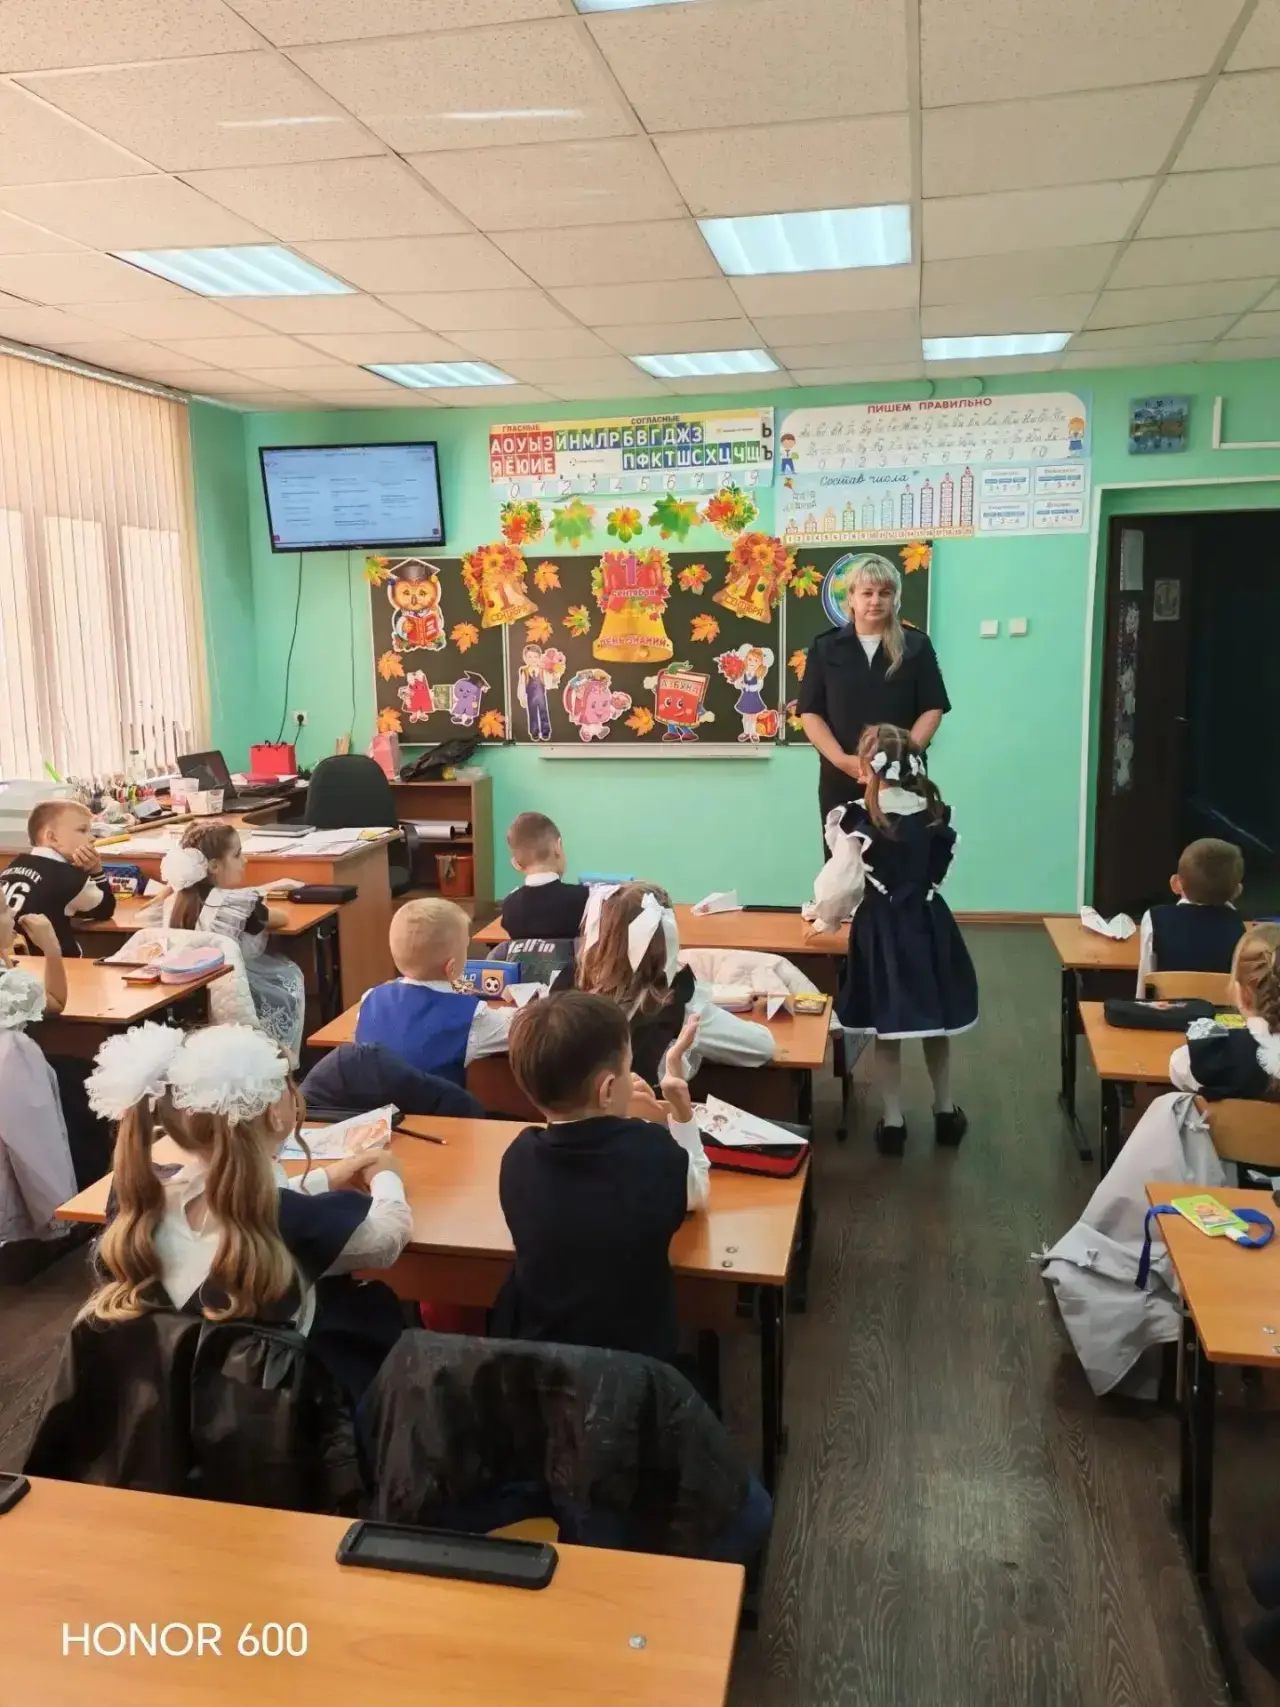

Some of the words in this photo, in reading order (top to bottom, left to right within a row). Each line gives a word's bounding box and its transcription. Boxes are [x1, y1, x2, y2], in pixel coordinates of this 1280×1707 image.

[868, 402, 912, 414] ПИШЕМ
[919, 397, 993, 410] ПРАВИЛЬНО
[630, 415, 680, 425] СОГЛАСНЫЕ
[502, 424, 541, 433] ГЛАСНЫЕ
[640, 476, 651, 491] 5
[667, 473, 677, 490] 6
[820, 473, 866, 486] Состав
[868, 473, 910, 483] числа
[620, 555, 638, 586] 1
